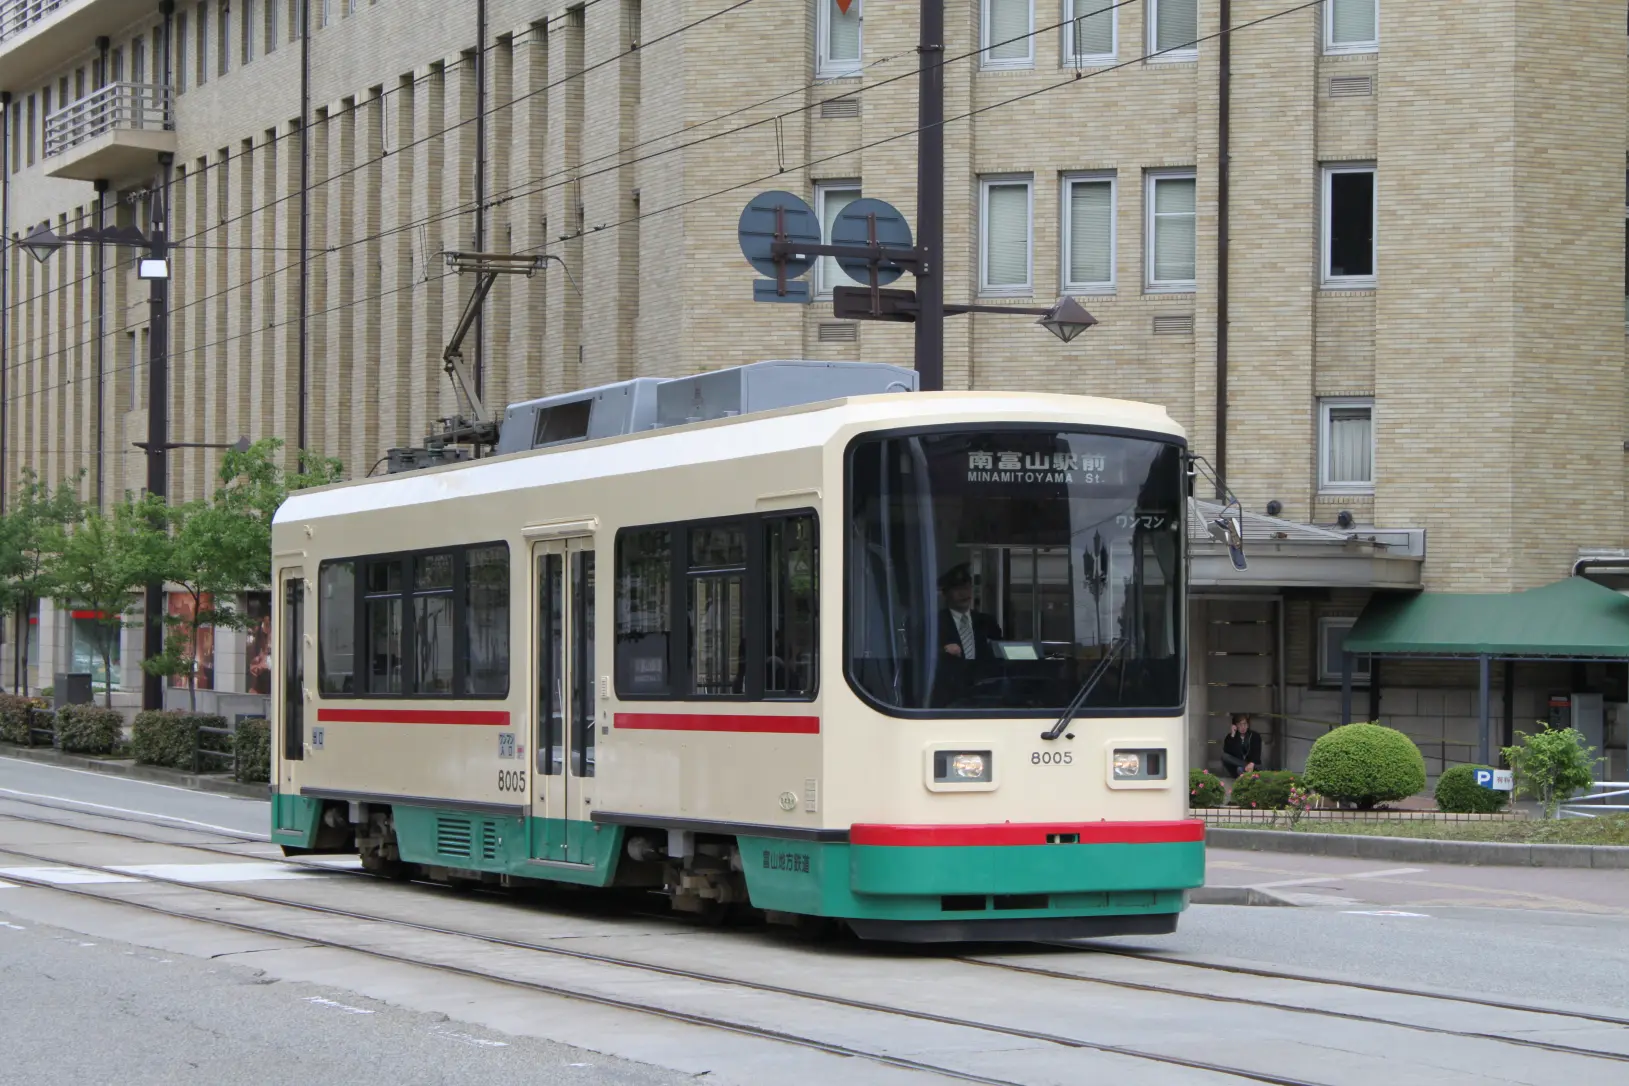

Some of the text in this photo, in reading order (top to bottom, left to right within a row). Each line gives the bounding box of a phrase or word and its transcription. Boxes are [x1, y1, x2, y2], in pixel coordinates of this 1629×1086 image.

[967, 451, 1106, 472] 南富山駅前
[967, 471, 1073, 484] MINAMITOYAMA
[1115, 515, 1165, 529] ワンマン
[1031, 752, 1073, 765] 8005
[498, 770, 526, 793] 8005
[1477, 770, 1491, 786] P
